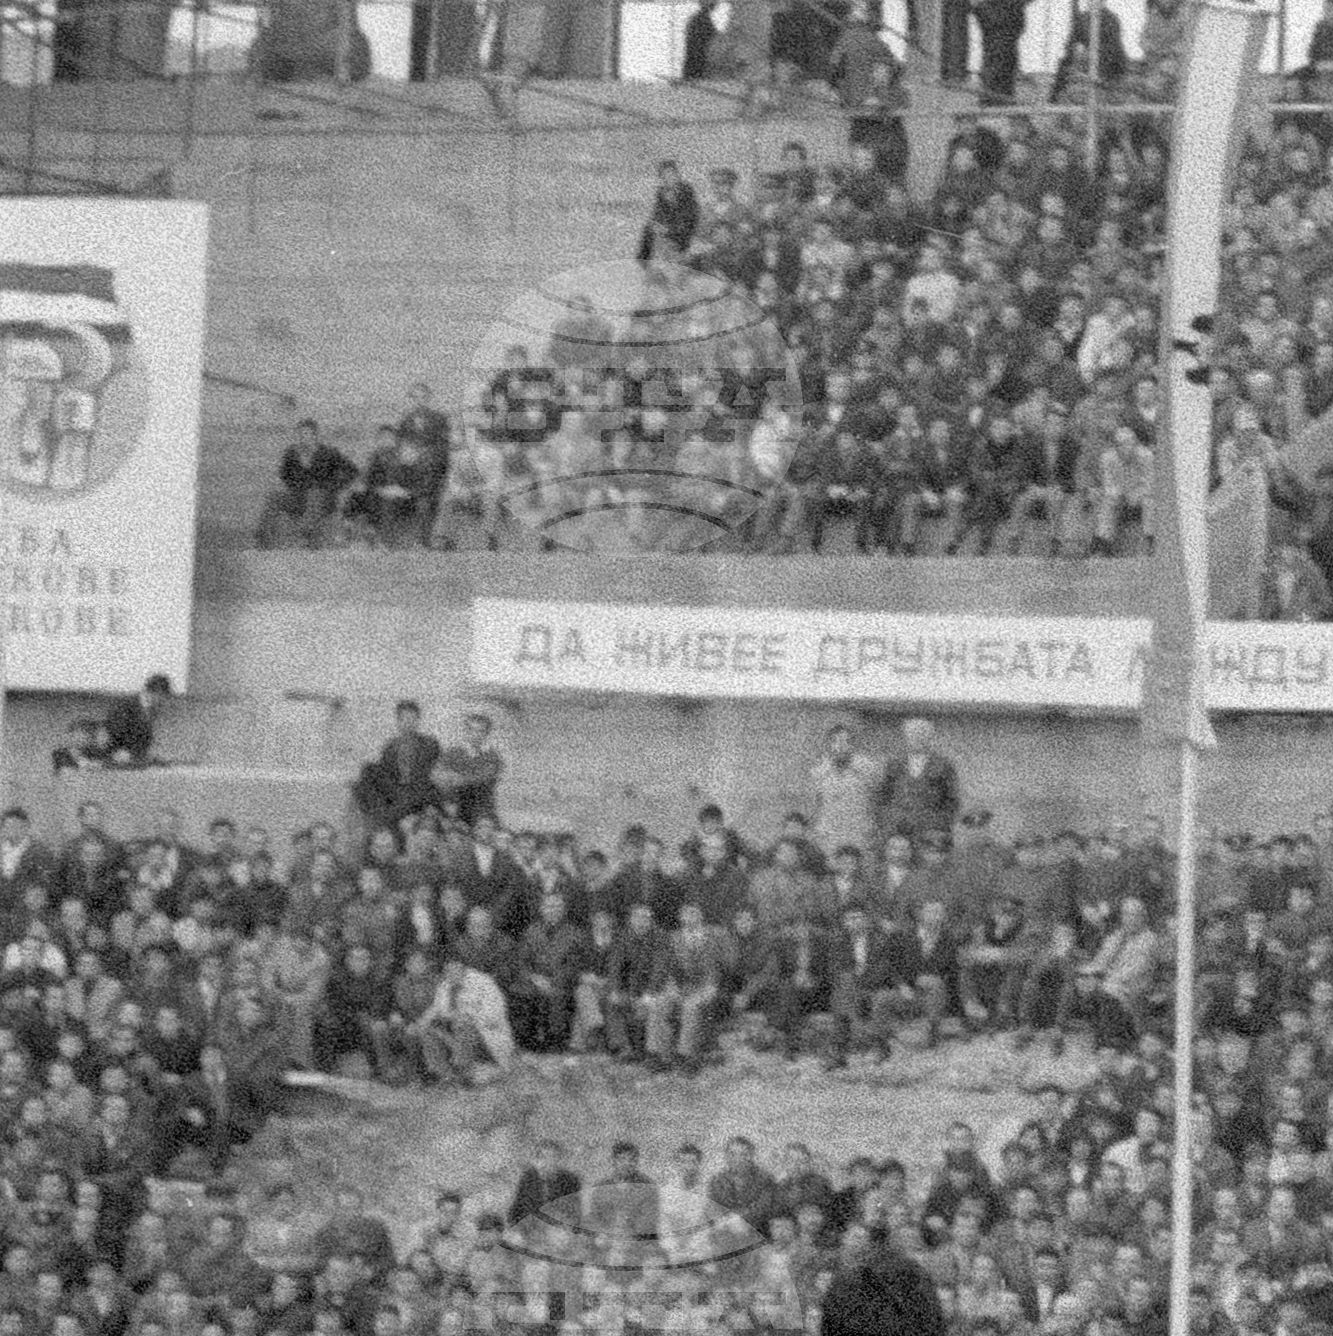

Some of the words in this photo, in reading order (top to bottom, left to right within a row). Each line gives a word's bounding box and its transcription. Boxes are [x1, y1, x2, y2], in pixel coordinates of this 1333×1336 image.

[515, 623, 589, 674] ДА
[613, 627, 788, 677] ЖИВЕЕ
[812, 632, 1096, 682] ДРУЖБАТА
[1126, 644, 1328, 694] ЖДУ
